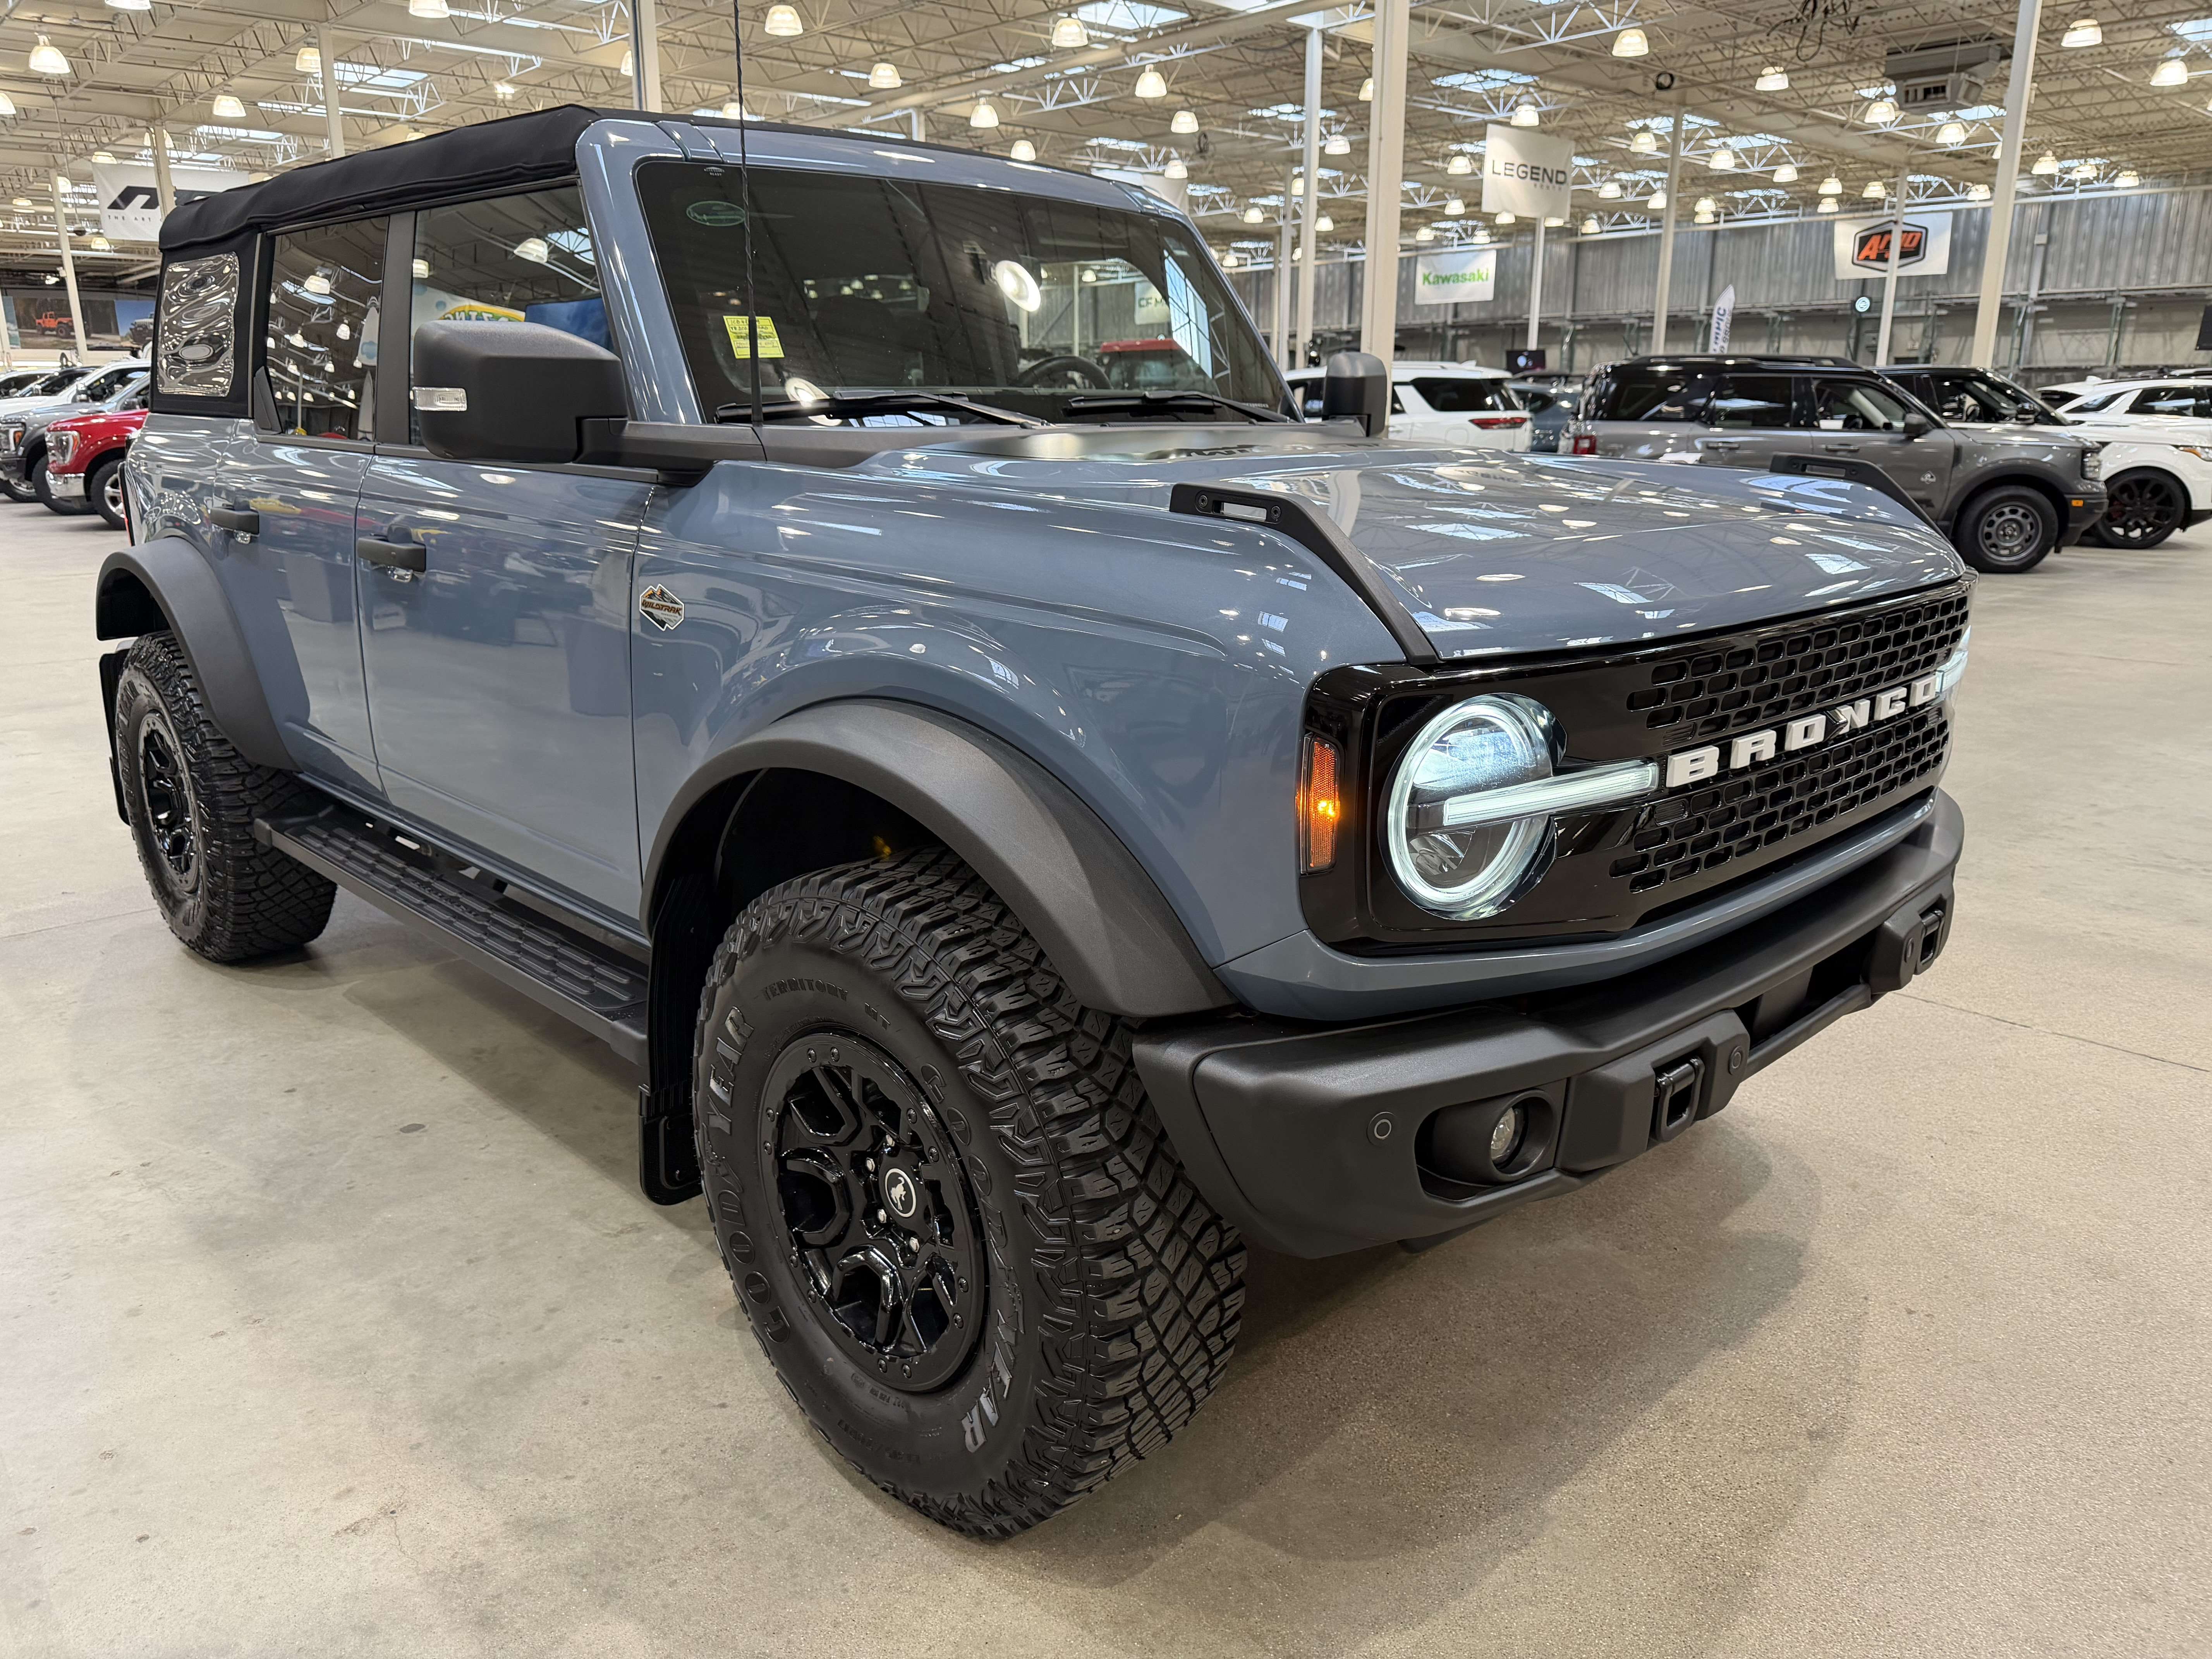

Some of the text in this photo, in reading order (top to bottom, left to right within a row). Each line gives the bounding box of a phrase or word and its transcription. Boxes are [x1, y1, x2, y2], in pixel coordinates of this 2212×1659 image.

[1492, 160, 1567, 184] LEGEND
[1422, 267, 1489, 285] Kawasaki
[642, 599, 683, 616] WILDTRAK
[1666, 674, 1936, 787] BRONCO
[761, 977, 848, 1001] TERRITORY
